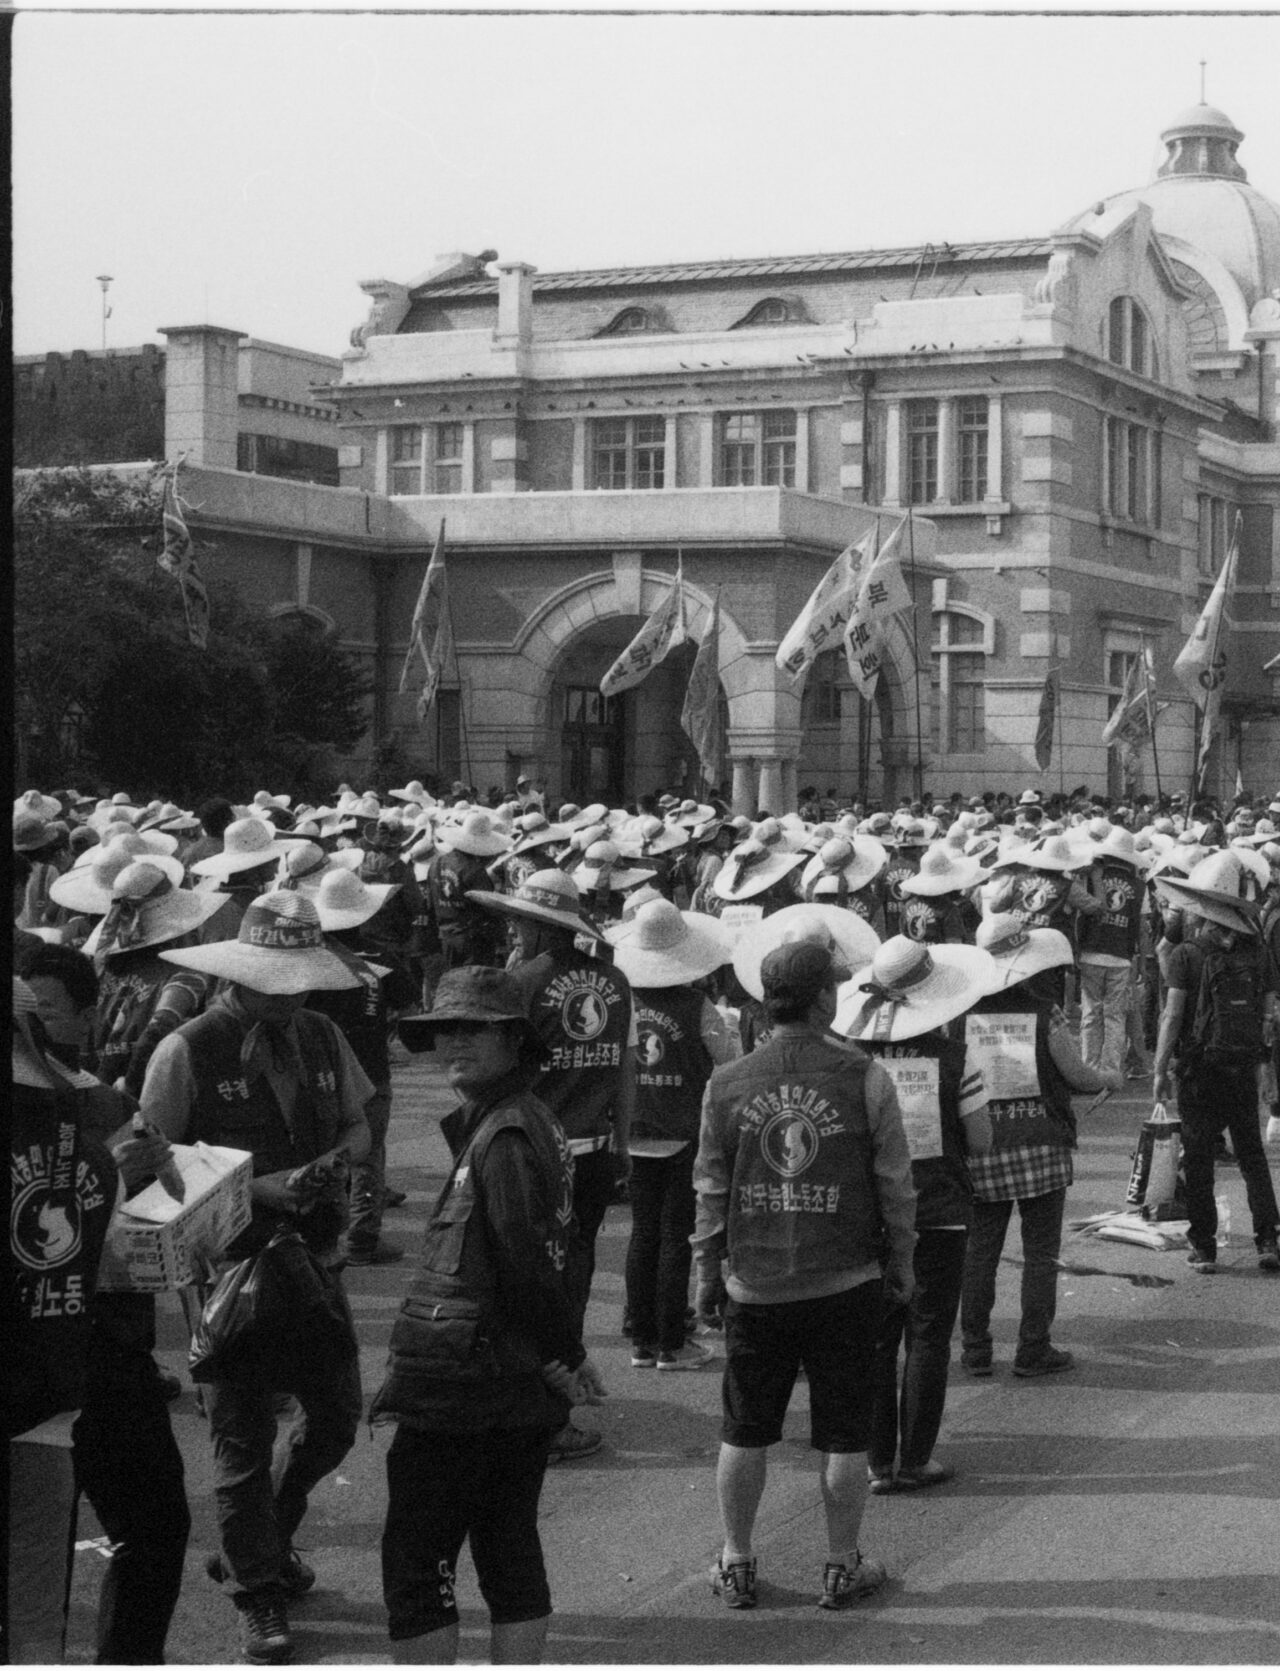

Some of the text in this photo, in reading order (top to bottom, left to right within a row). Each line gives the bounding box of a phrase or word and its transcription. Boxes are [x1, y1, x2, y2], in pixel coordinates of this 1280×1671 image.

[217, 1077, 250, 1101] 단결
[738, 1084, 847, 1138] 노동자농민연대의구심
[739, 1182, 841, 1214] 전국농협노동조합
[1126, 1173, 1143, 1202] NH
